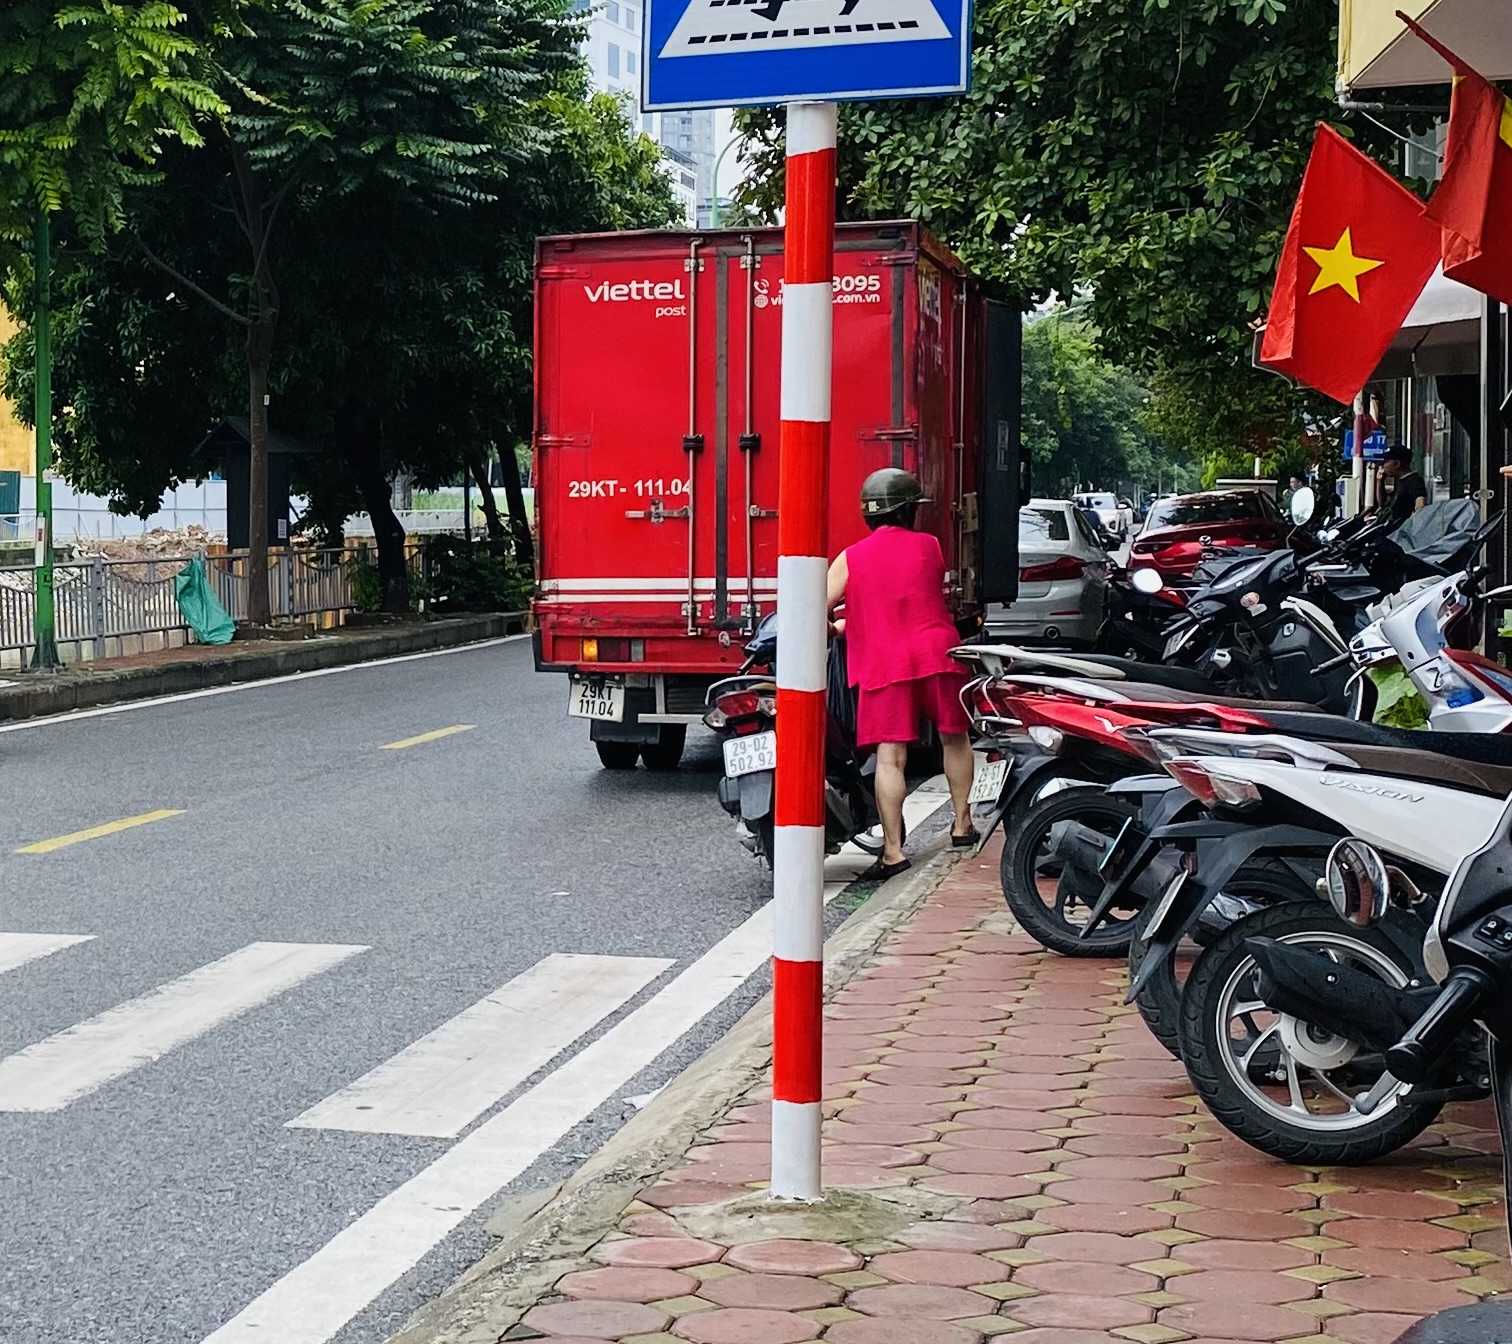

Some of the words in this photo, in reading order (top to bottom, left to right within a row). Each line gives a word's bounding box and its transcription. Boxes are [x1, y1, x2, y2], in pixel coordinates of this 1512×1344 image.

[584, 279, 685, 302] viettel
[655, 305, 687, 318] post
[581, 683, 614, 701] 29KT
[578, 698, 614, 717] 111.04
[1319, 776, 1425, 803] VISION
